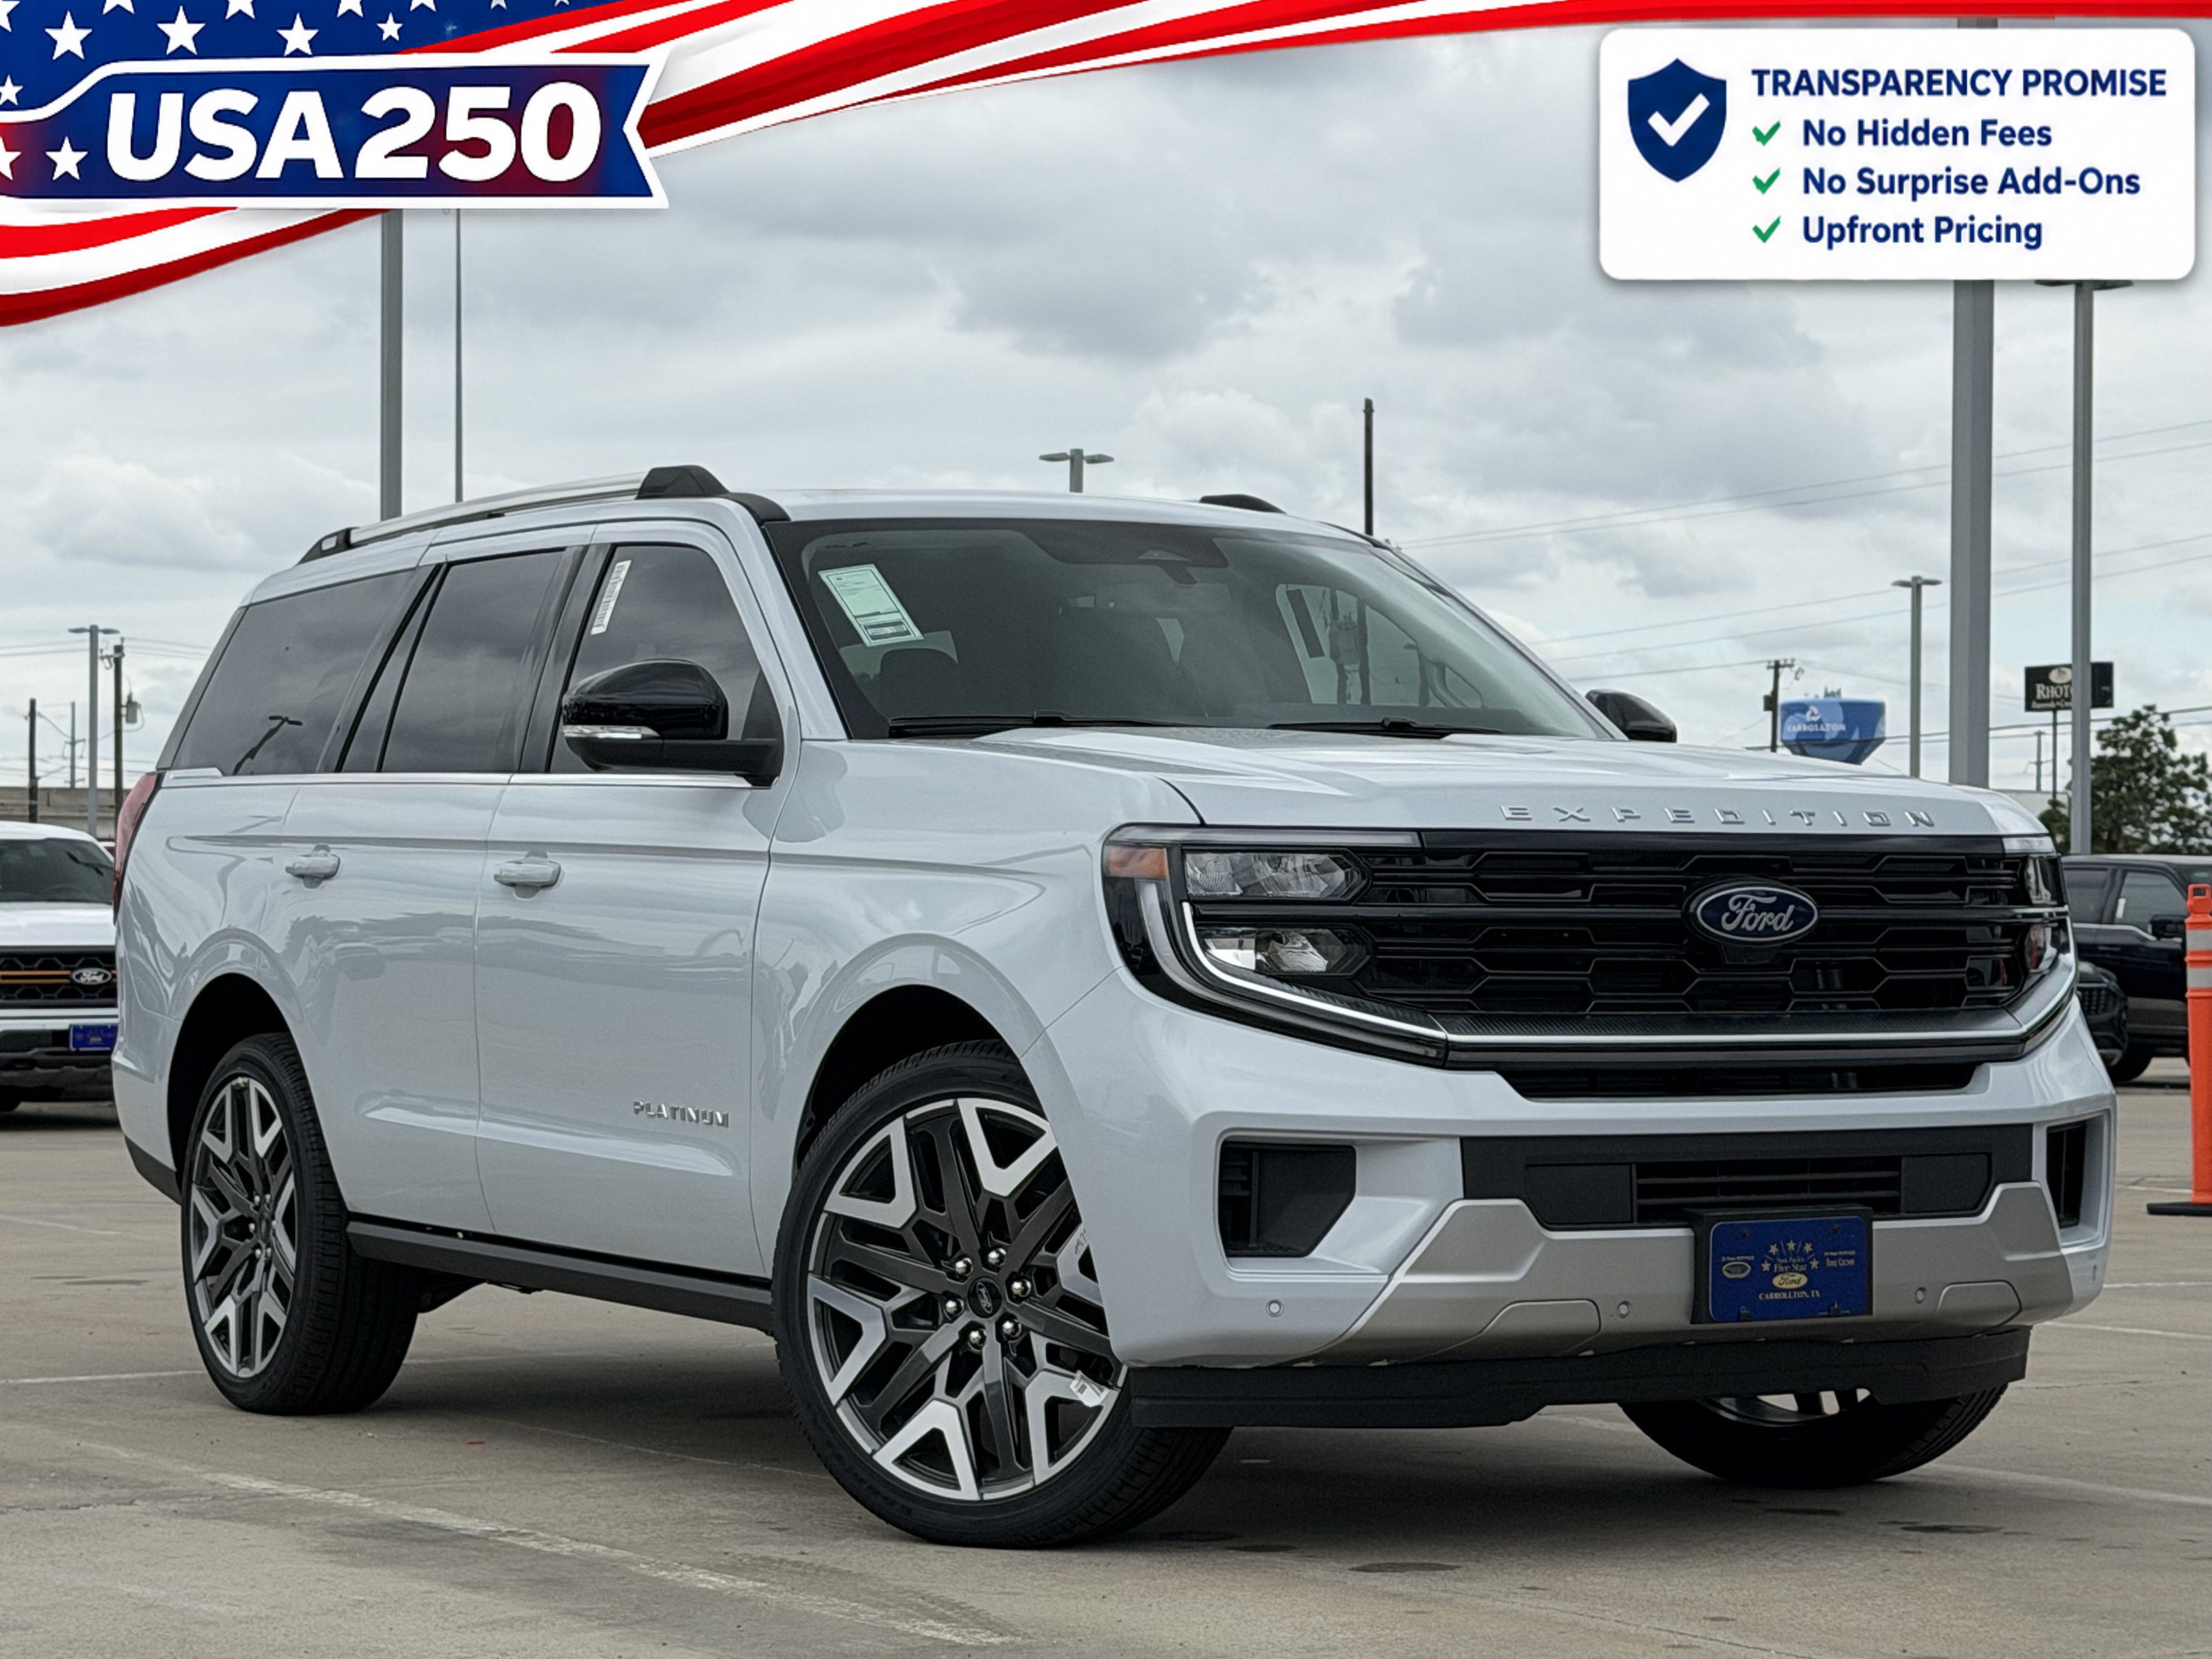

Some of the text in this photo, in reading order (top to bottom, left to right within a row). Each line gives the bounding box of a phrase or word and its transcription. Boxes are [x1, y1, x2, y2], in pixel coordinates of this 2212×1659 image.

[1499, 804, 1936, 827] EXPEDITION
[1721, 894, 1796, 932] Ford
[633, 1099, 729, 1128] PLATINUM
